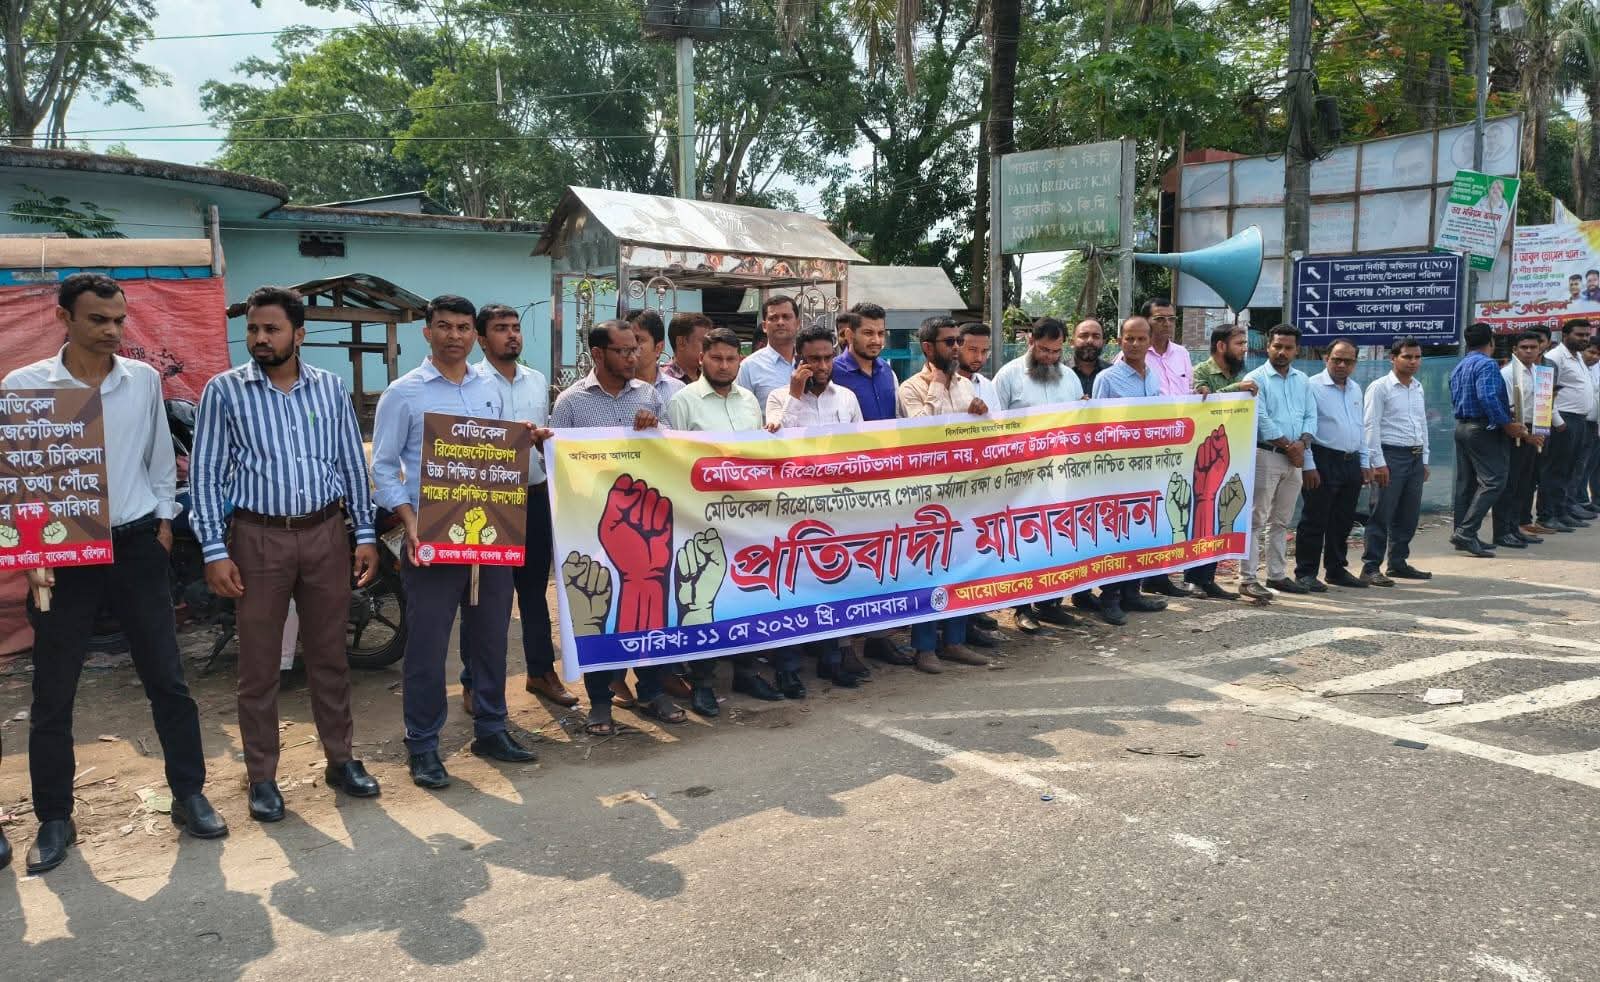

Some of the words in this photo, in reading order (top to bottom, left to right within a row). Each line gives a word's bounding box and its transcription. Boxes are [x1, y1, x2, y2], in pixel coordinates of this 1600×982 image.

[1041, 177, 1081, 192] BRIDGE
[1333, 263, 1363, 272] উপজেলা
[1365, 261, 1387, 271] নির্বাহী
[1420, 259, 1452, 271] (UNO)
[1333, 287, 1374, 297] বাকেরগঞ্জ
[1377, 284, 1414, 296] পৌরসভা
[1416, 282, 1450, 295] কার্যালয়
[1356, 303, 1401, 313] বাকেরগঞ্জ
[1404, 302, 1425, 313] থানা
[1336, 320, 1376, 331] উপজেলা
[1379, 320, 1402, 332] স্বাস্থ্য
[1405, 320, 1444, 331] কমপ্লেক্স
[451, 419, 508, 441] মেডিকেল
[6, 448, 44, 468] কাছে
[47, 444, 103, 466] চিকিৎসা
[434, 438, 517, 463] রিপ্রেজেন্টেটিভগণ
[568, 451, 607, 461] অধিকার
[609, 451, 641, 460] আদায়ে
[702, 460, 776, 483] মেডিকেল
[780, 454, 904, 480] রিপ্রেজেন্টেটিভগণ
[908, 450, 949, 469] দালাল
[952, 447, 979, 465] নয়,
[982, 439, 1026, 459] এদেশের
[1028, 429, 1081, 452] উচ্চশিক্ষিত
[1084, 433, 1091, 444] ও
[1094, 424, 1141, 445] প্রশিক্ষিত
[1143, 420, 1186, 441] জনগোষ্ঠী
[22, 475, 54, 493] তথ্য
[427, 460, 444, 479] উচ্চ
[447, 461, 477, 481] শিক্ষিত
[480, 469, 486, 480] ও
[488, 464, 521, 486] চিকিৎসা
[451, 484, 489, 503] প্রশিক্ষিত
[704, 494, 772, 522] মেডিকেল
[776, 486, 892, 517] রিপ্রেজেন্টেটিভদের
[895, 484, 933, 506] পেশার
[936, 475, 969, 500] মর্যাদা
[970, 475, 991, 495] রক্ষা
[994, 475, 1002, 491] ও
[1004, 467, 1036, 489] নিরাপদ
[1037, 458, 1055, 482] কর্ম
[1057, 456, 1092, 480] পরিবেশ
[1093, 453, 1126, 476] নিশ্চিত
[1128, 454, 1153, 473] করার
[1155, 448, 1183, 470] দাবীতে
[15, 502, 44, 519] দক্ষ
[48, 495, 100, 516] কারিগর
[730, 503, 964, 600] প্রতিবাদী
[972, 489, 1164, 563] মানববন্ধন
[1038, 568, 1088, 588] বাকেরগঞ্জ
[1090, 554, 1132, 575] ফারিয়া,
[697, 632, 720, 647] ১১
[728, 623, 750, 642] মে
[756, 614, 809, 637] ২০২৬
[815, 604, 840, 627] খ্রি.
